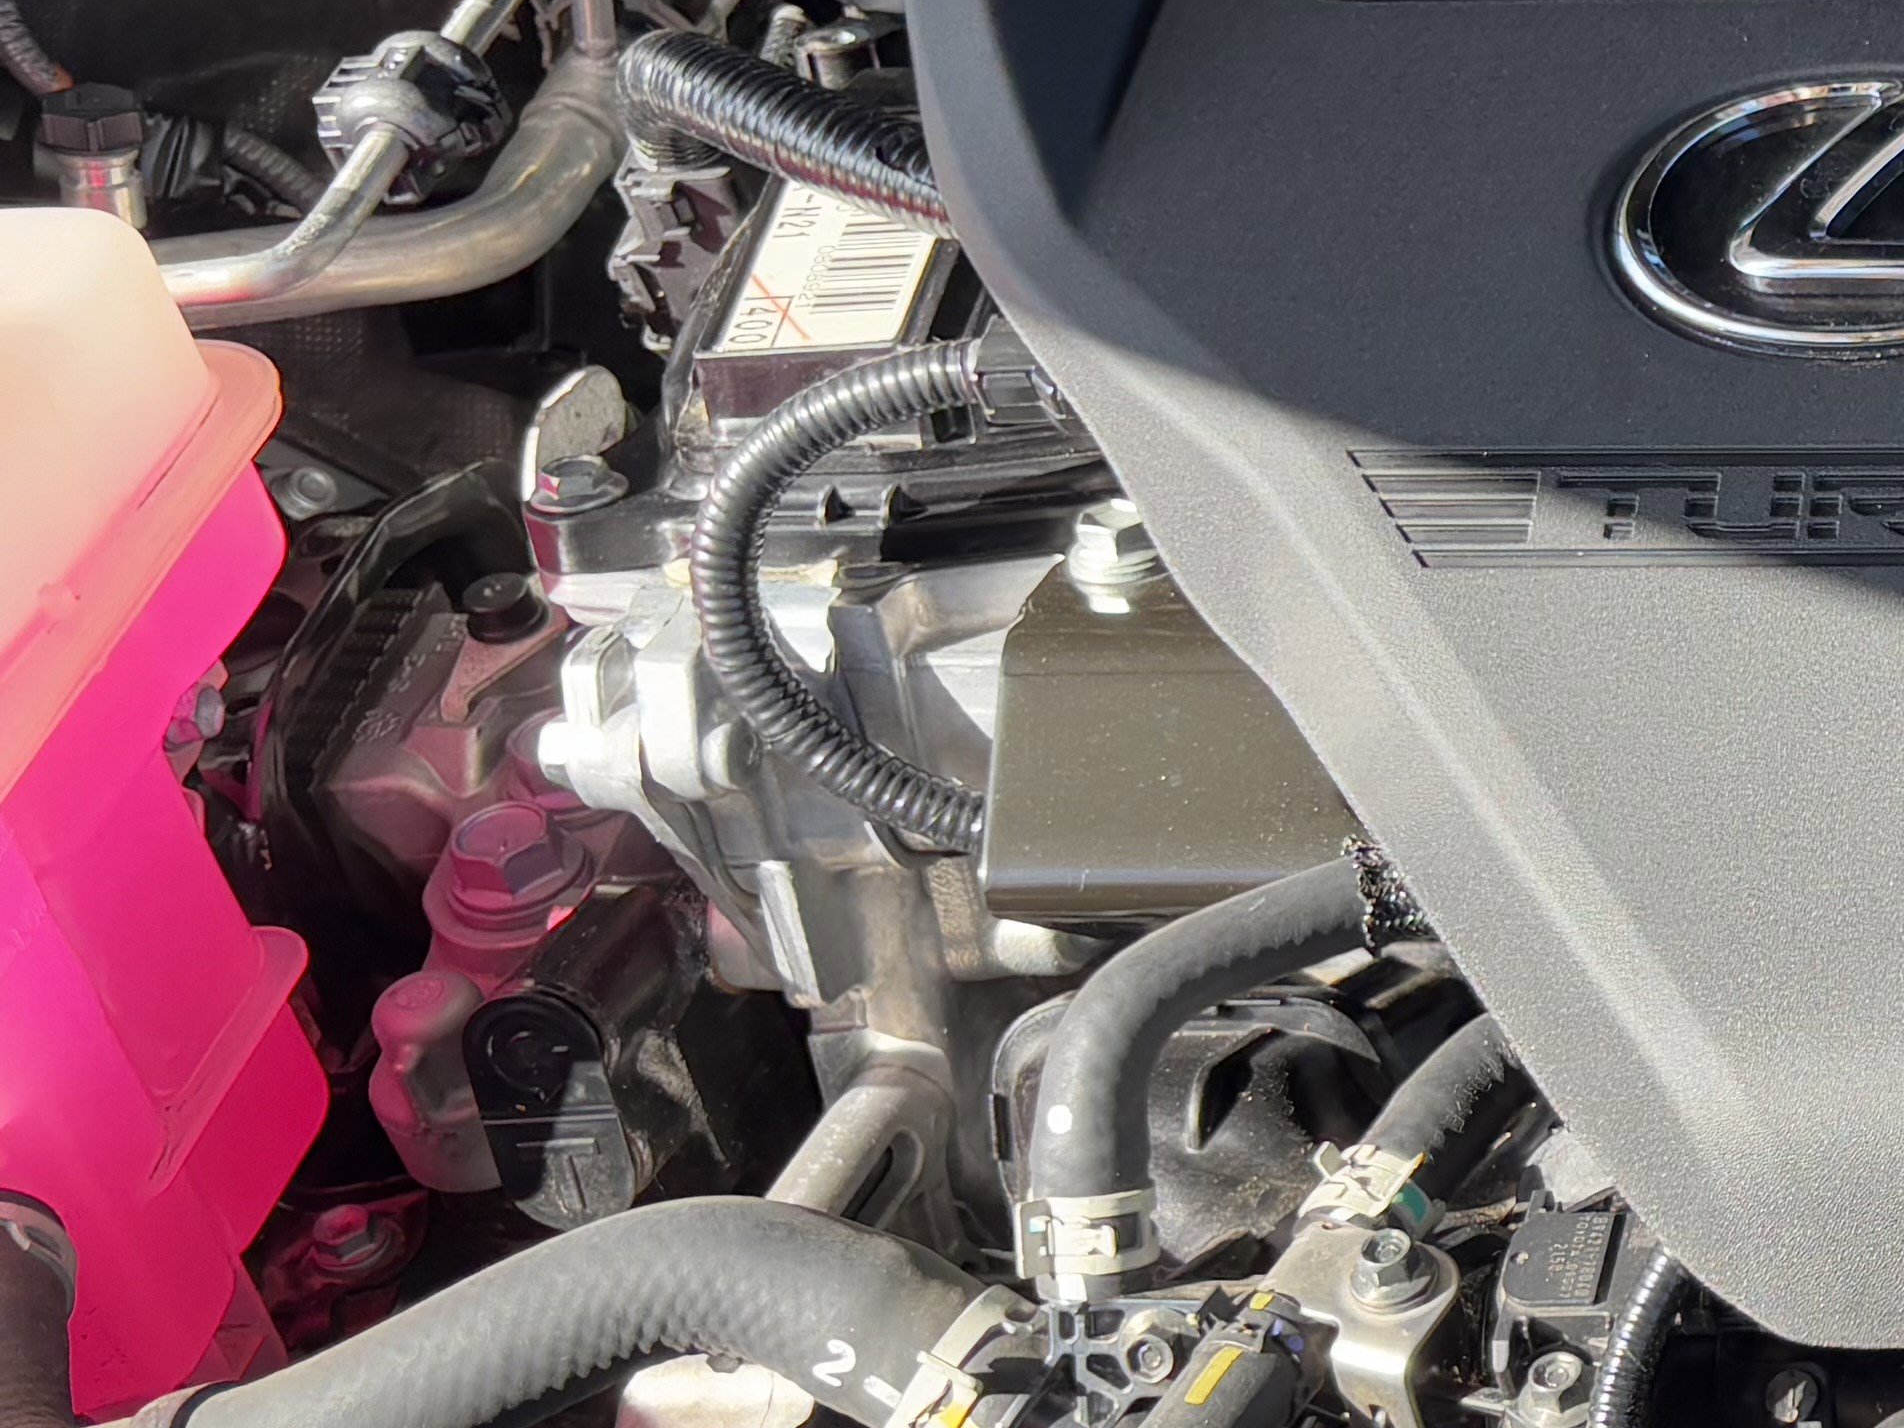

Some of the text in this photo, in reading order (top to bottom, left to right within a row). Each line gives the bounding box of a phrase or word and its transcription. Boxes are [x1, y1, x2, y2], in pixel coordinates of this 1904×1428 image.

[772, 185, 821, 239] -N21
[728, 306, 777, 346] 400
[812, 1339, 858, 1389] 2
